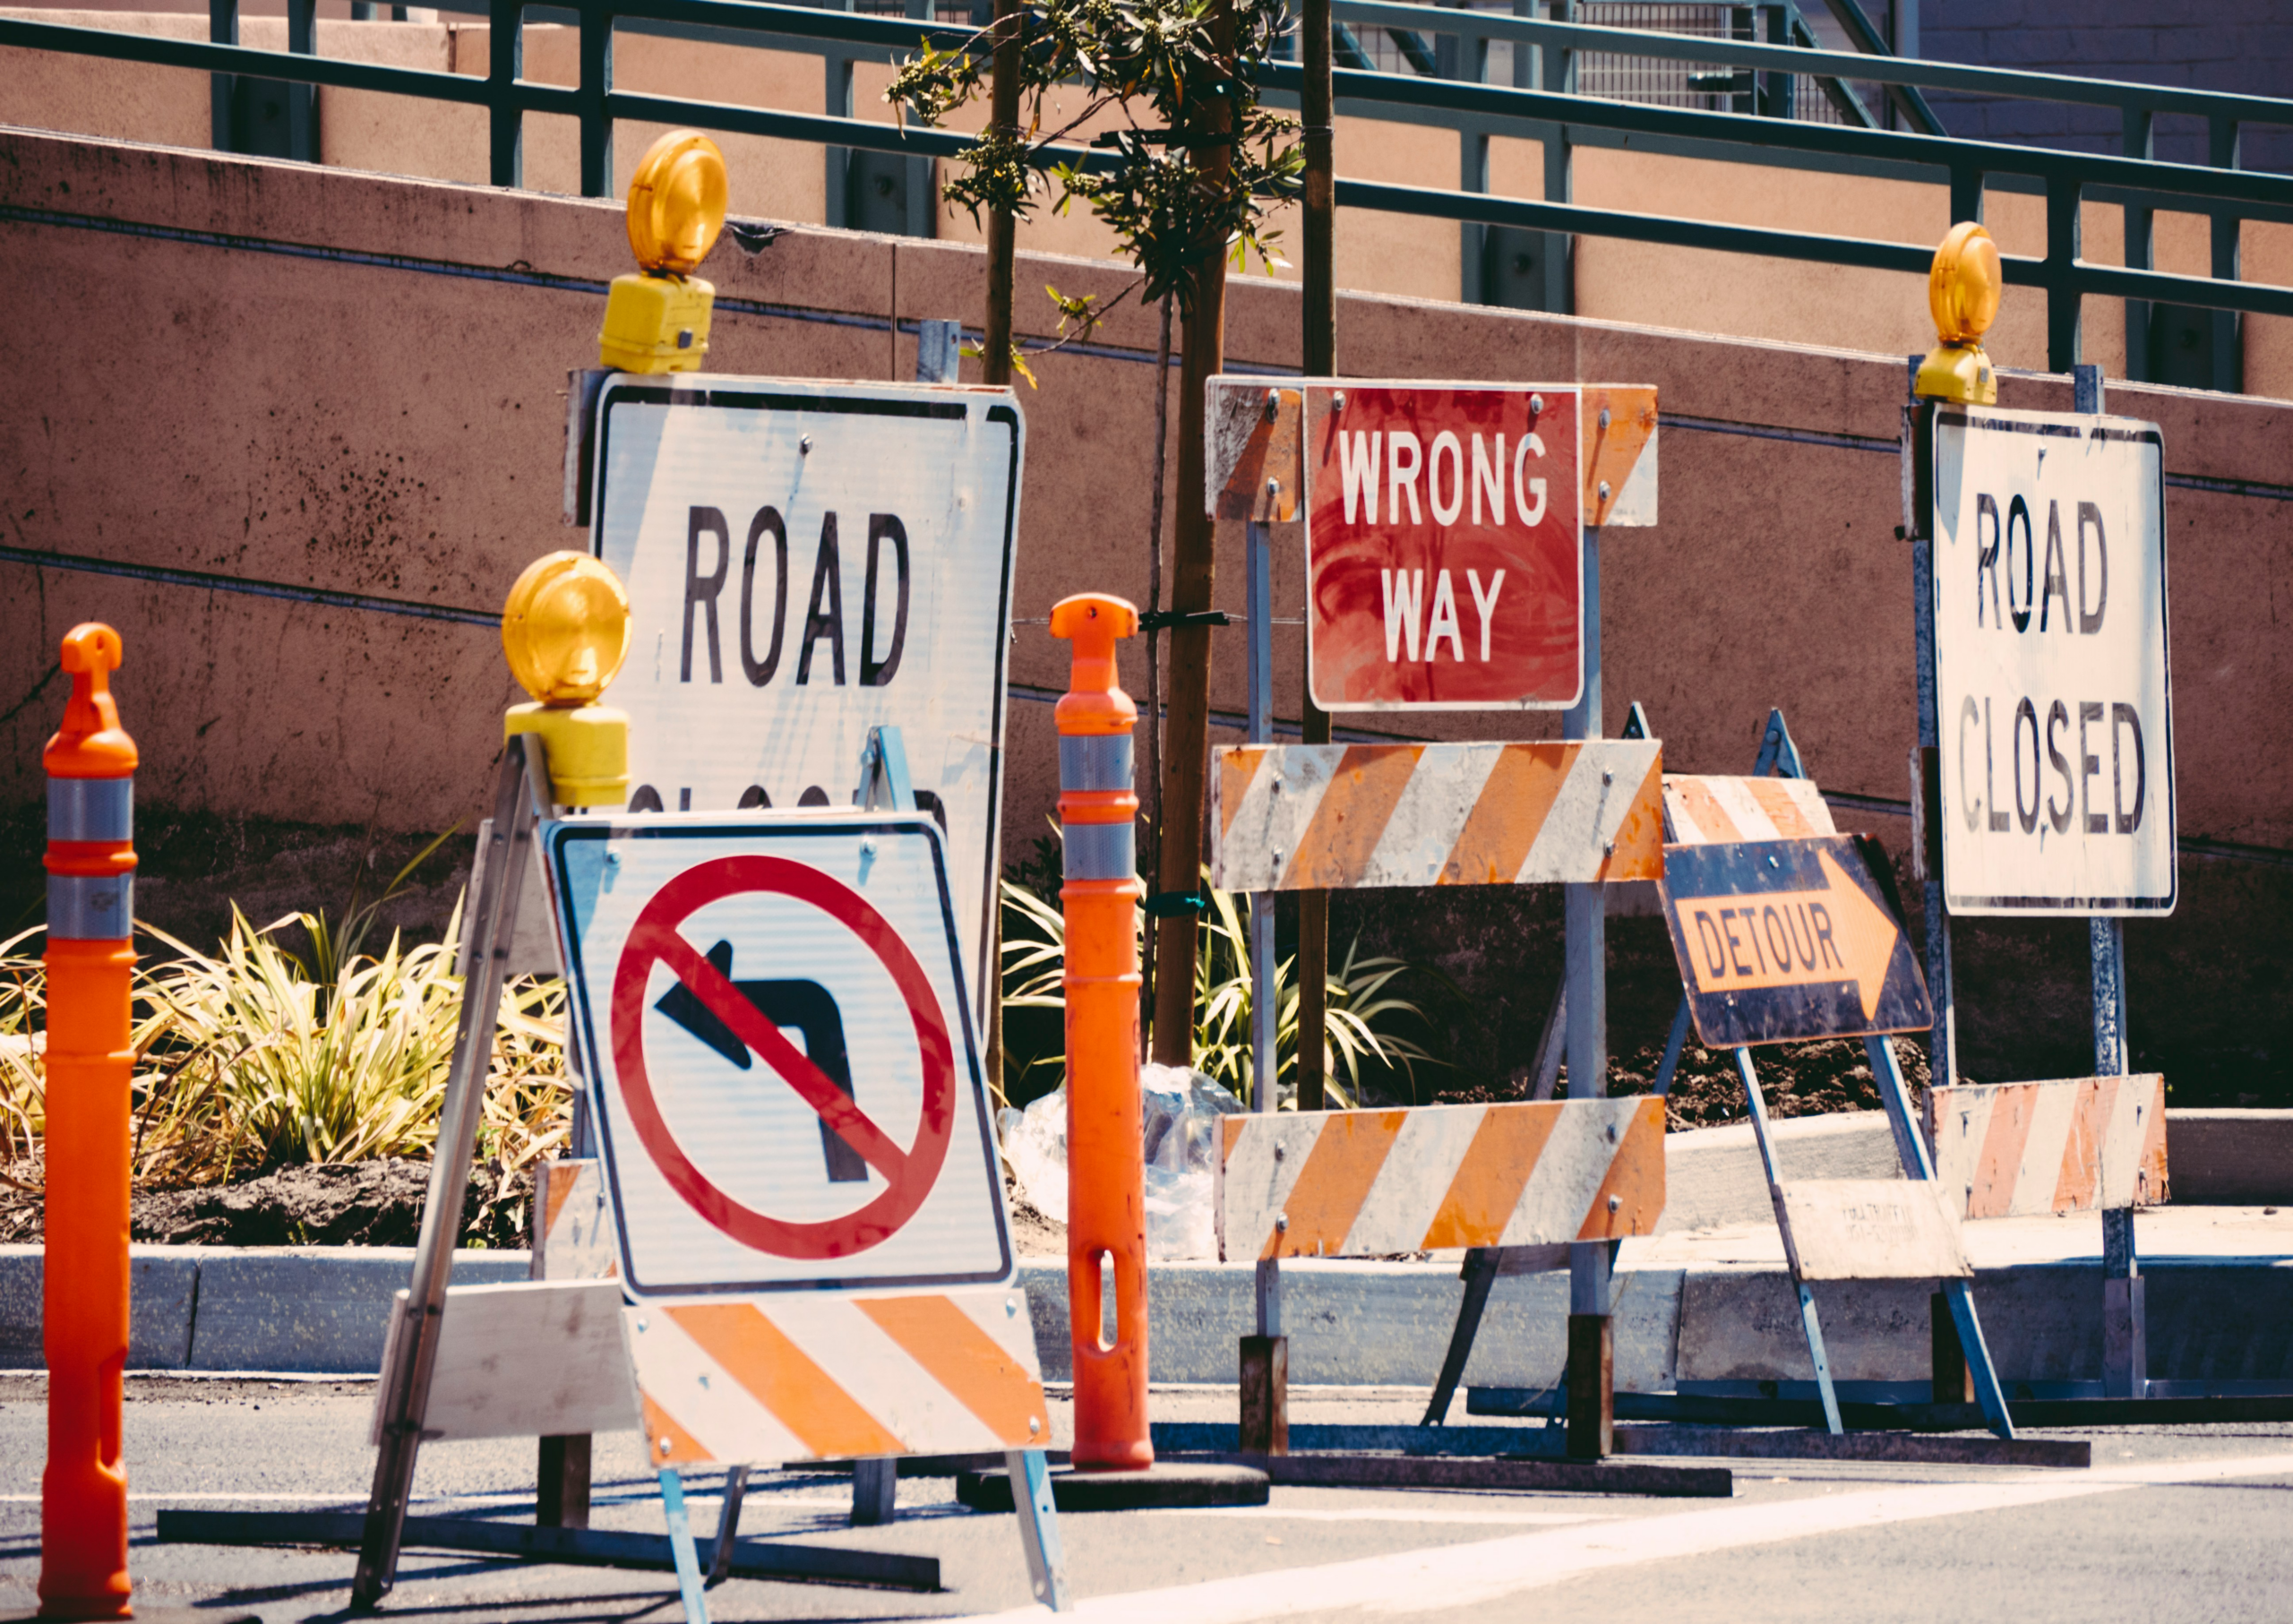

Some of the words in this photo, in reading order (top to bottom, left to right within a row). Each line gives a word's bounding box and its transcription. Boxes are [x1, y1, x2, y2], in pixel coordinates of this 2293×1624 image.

[1338, 430, 1548, 528] WRONG
[680, 504, 911, 688] ROAD
[1380, 568, 1507, 663] WAY
[1976, 493, 2108, 635] ROAD
[1959, 694, 2146, 835] CLOSED
[1693, 902, 1845, 979] DETOUR
